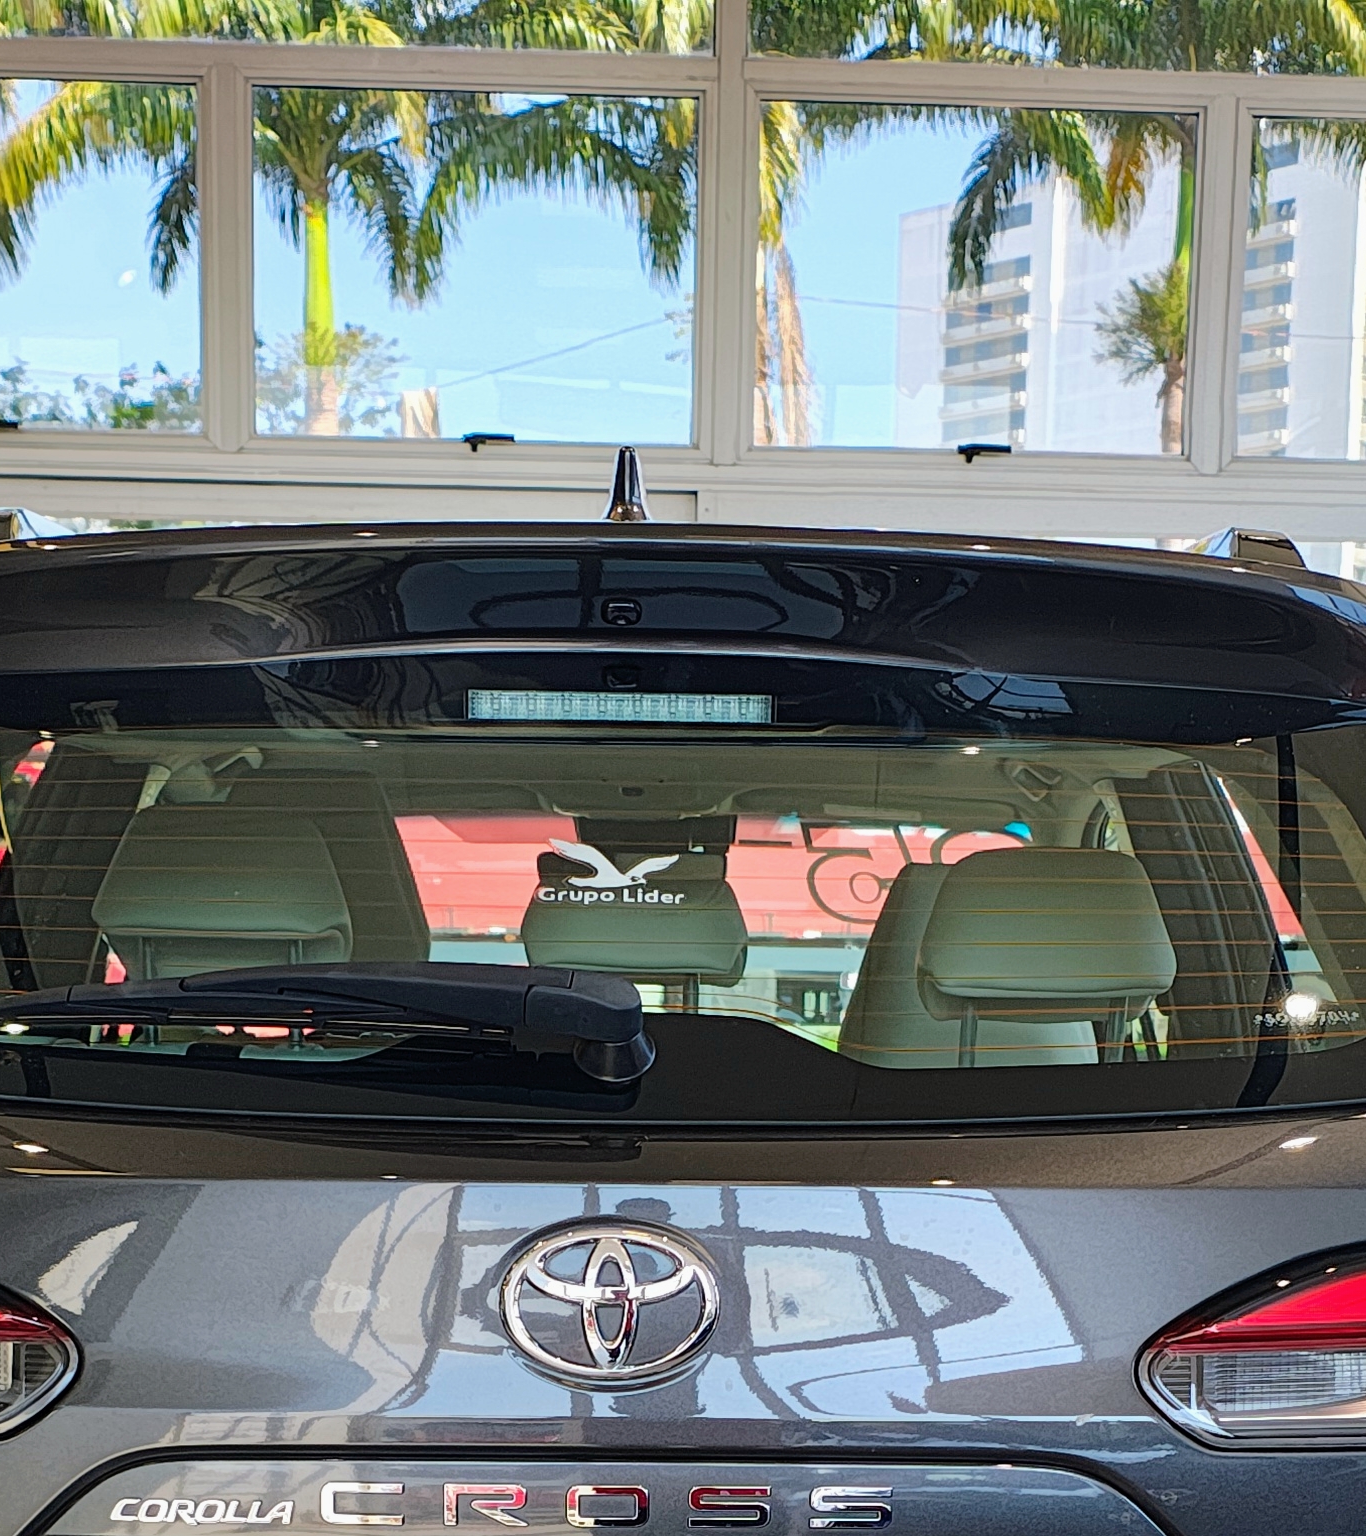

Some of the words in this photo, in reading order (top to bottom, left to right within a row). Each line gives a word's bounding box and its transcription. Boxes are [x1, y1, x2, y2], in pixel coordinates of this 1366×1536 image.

[537, 887, 616, 906] Grupo
[109, 1497, 295, 1527] COROLLA
[319, 1480, 894, 1530] CROSS
